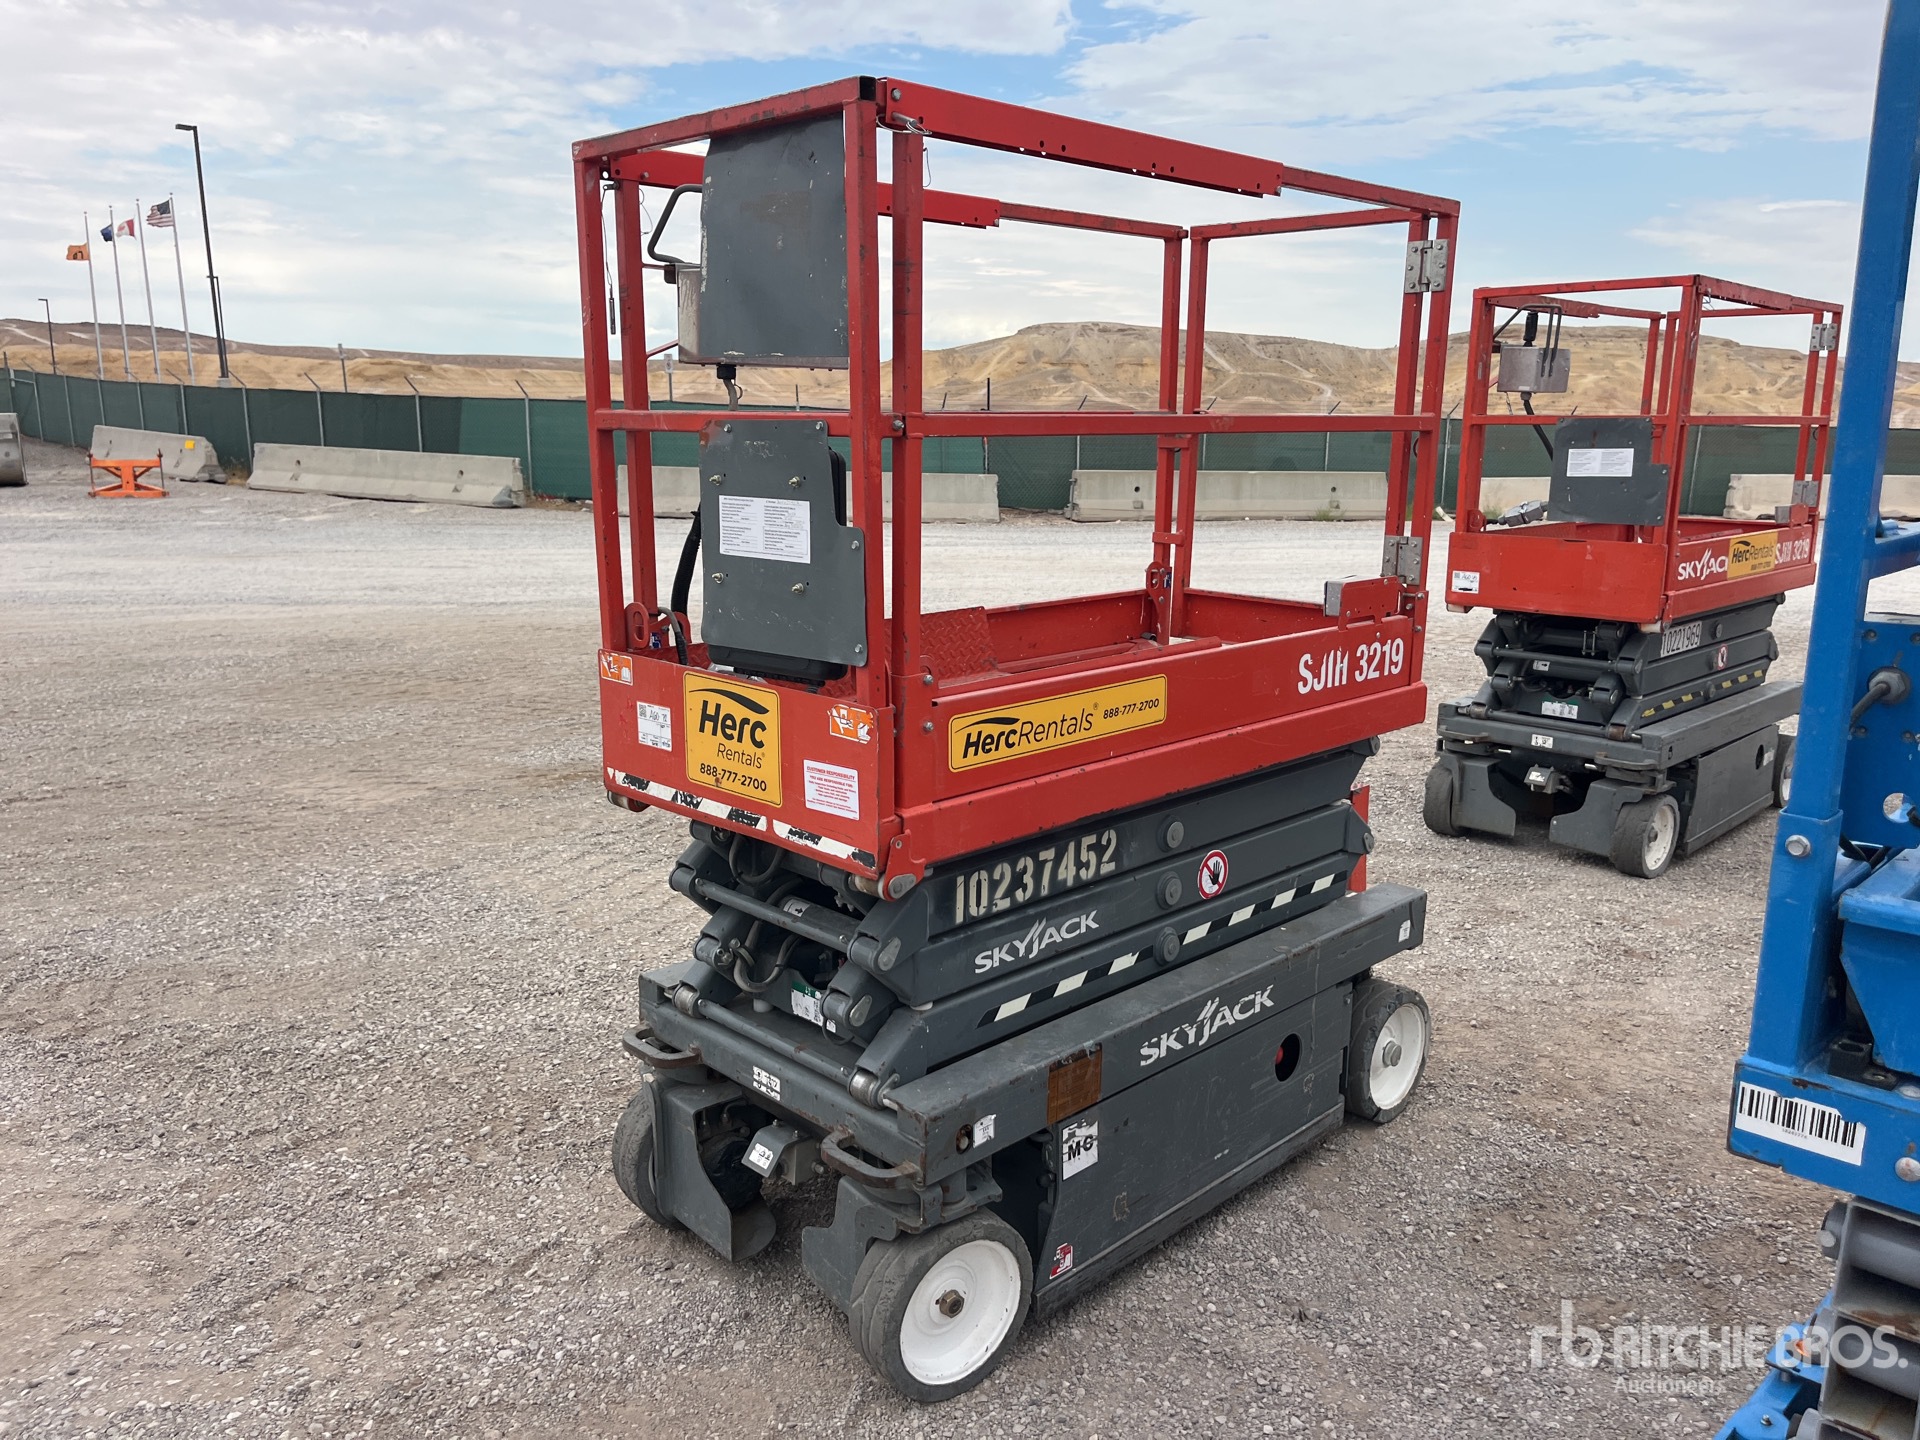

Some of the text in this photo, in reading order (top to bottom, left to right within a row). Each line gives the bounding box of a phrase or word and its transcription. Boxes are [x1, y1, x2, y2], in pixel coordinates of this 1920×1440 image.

[1677, 548, 1728, 580] SKYJAC
[1355, 638, 1404, 682] 3219
[1662, 623, 1701, 655] 10221969
[698, 700, 767, 749] Herc
[1102, 698, 1160, 720] 888-777-2700
[699, 763, 767, 792] 888-777-2700
[955, 829, 1118, 926] 10237452
[974, 909, 1100, 974] SKYJACK
[1139, 984, 1275, 1066] SKYJACK
